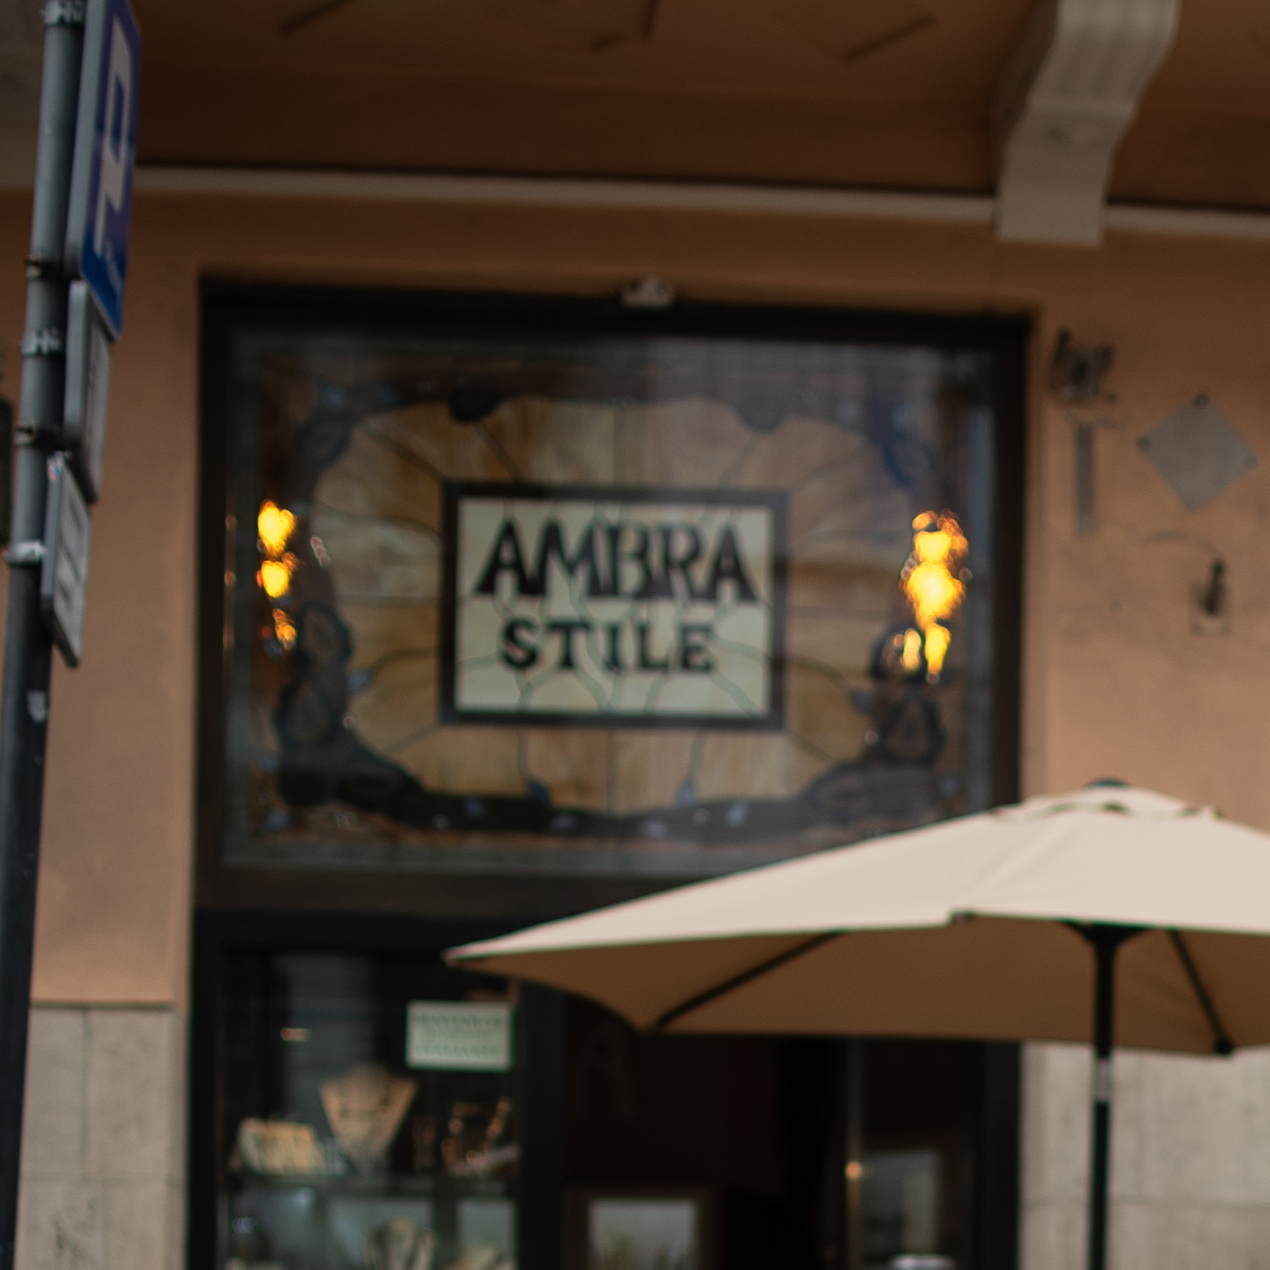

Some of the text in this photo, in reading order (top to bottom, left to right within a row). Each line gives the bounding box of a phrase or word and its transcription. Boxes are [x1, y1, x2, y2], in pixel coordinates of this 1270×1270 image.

[92, 12, 133, 259] P
[474, 518, 760, 602] AMBRA
[502, 618, 714, 673] STILE
